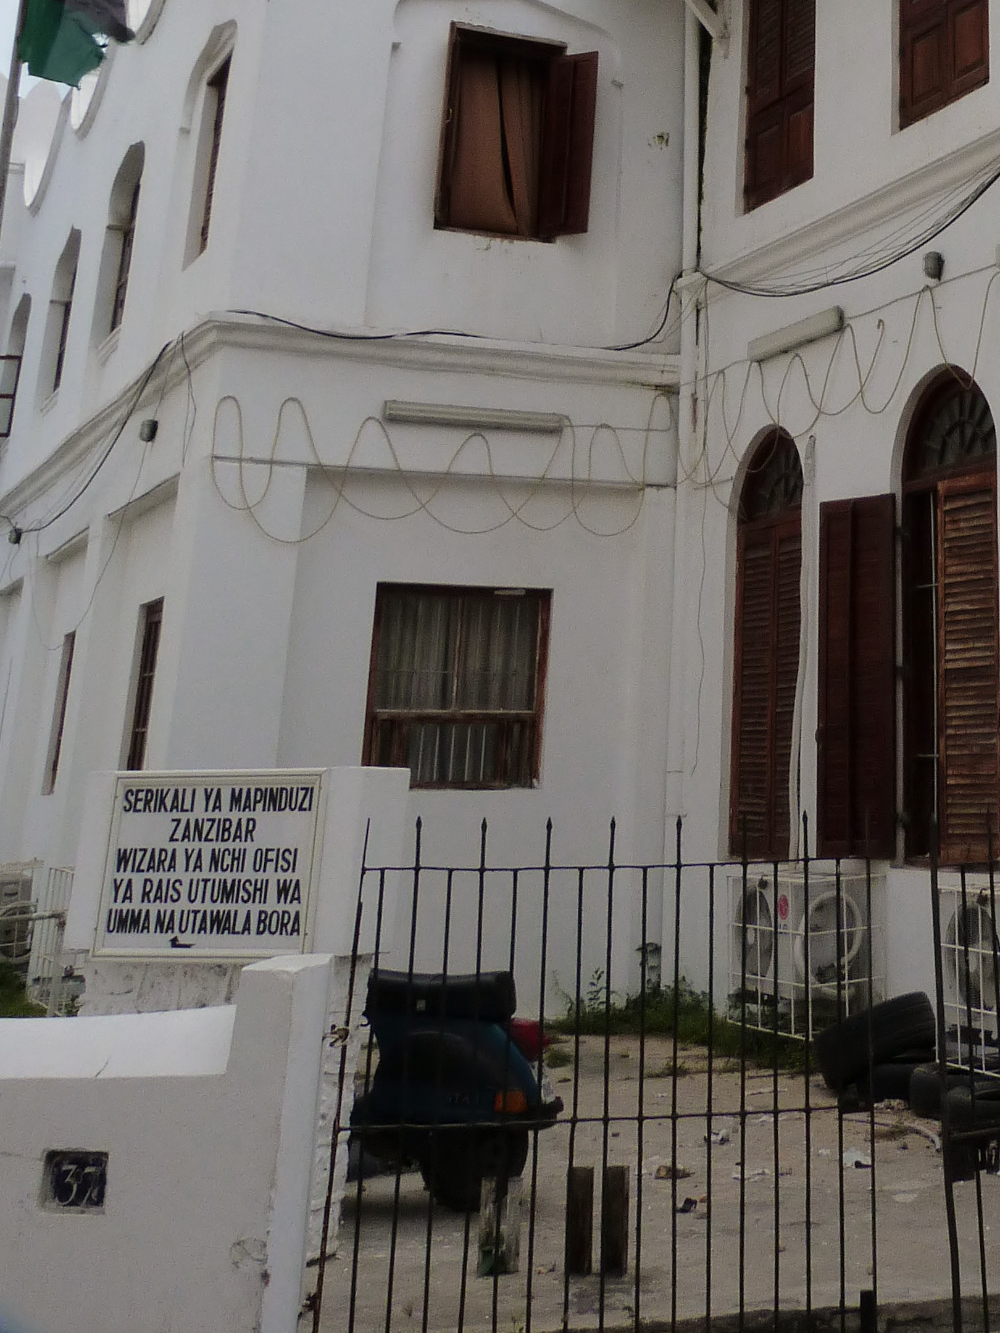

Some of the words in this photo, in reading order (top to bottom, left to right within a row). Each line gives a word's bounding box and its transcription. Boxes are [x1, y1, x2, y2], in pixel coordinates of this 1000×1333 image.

[123, 788, 196, 813] SERIKALI
[204, 787, 222, 812] YA
[229, 786, 315, 812] MAPINDUZI
[168, 818, 256, 843] ZANZIBAR
[116, 848, 176, 873] WIZARA
[184, 848, 202, 872] YA
[209, 848, 246, 873] NCHI
[253, 848, 299, 873] OFISI
[113, 878, 133, 904] YA
[141, 878, 183, 904] RAIS
[187, 878, 268, 905] UTUMISHI
[277, 878, 301, 904] WA
[107, 909, 150, 934] UMMA
[154, 909, 175, 934] NA
[179, 909, 251, 935] UTAWALA
[256, 910, 301, 936] BORA
